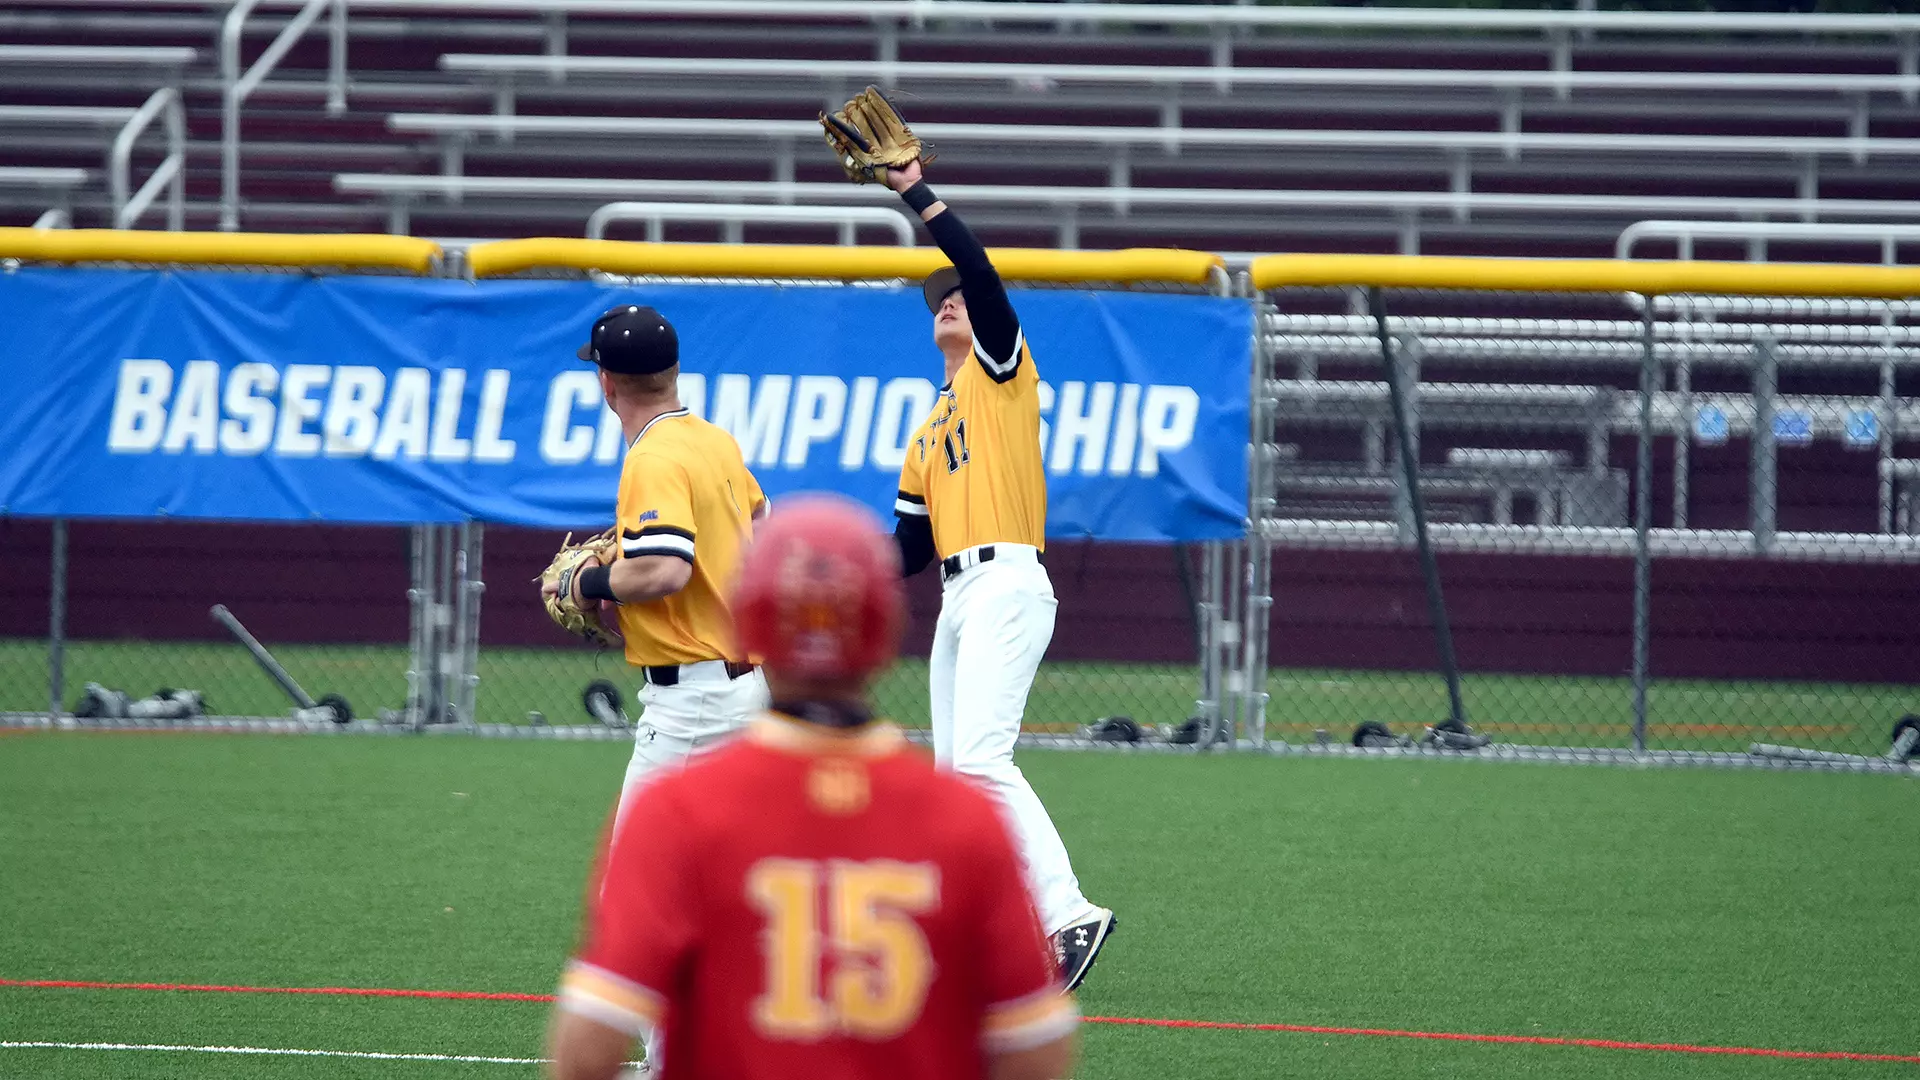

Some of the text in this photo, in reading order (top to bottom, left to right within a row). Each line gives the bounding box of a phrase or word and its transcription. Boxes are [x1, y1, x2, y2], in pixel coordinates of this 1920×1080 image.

[107, 358, 517, 463] BASEBALL
[540, 370, 1200, 478] CMPIOHIP
[943, 417, 970, 475] 11
[745, 857, 943, 1043] 15
